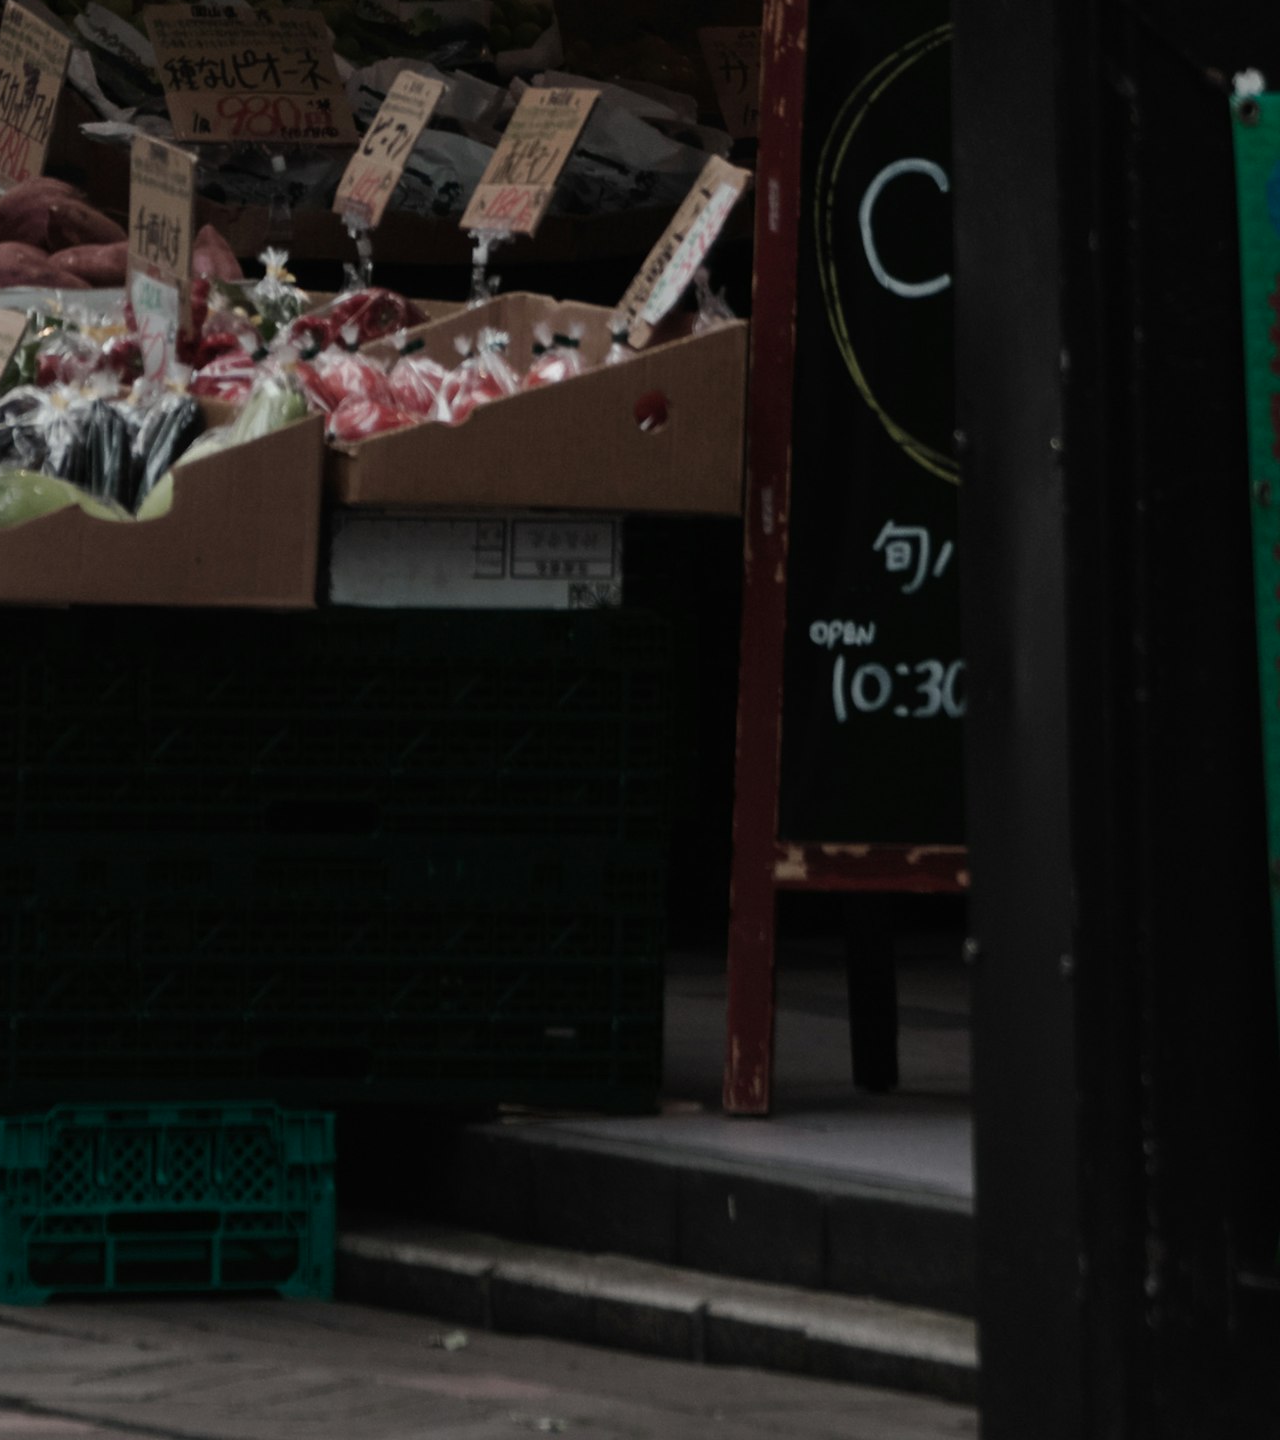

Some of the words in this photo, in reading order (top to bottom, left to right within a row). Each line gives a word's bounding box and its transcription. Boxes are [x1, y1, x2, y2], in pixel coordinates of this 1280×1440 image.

[163, 48, 332, 91] 種なしピオーネ
[809, 618, 877, 650] OPEN
